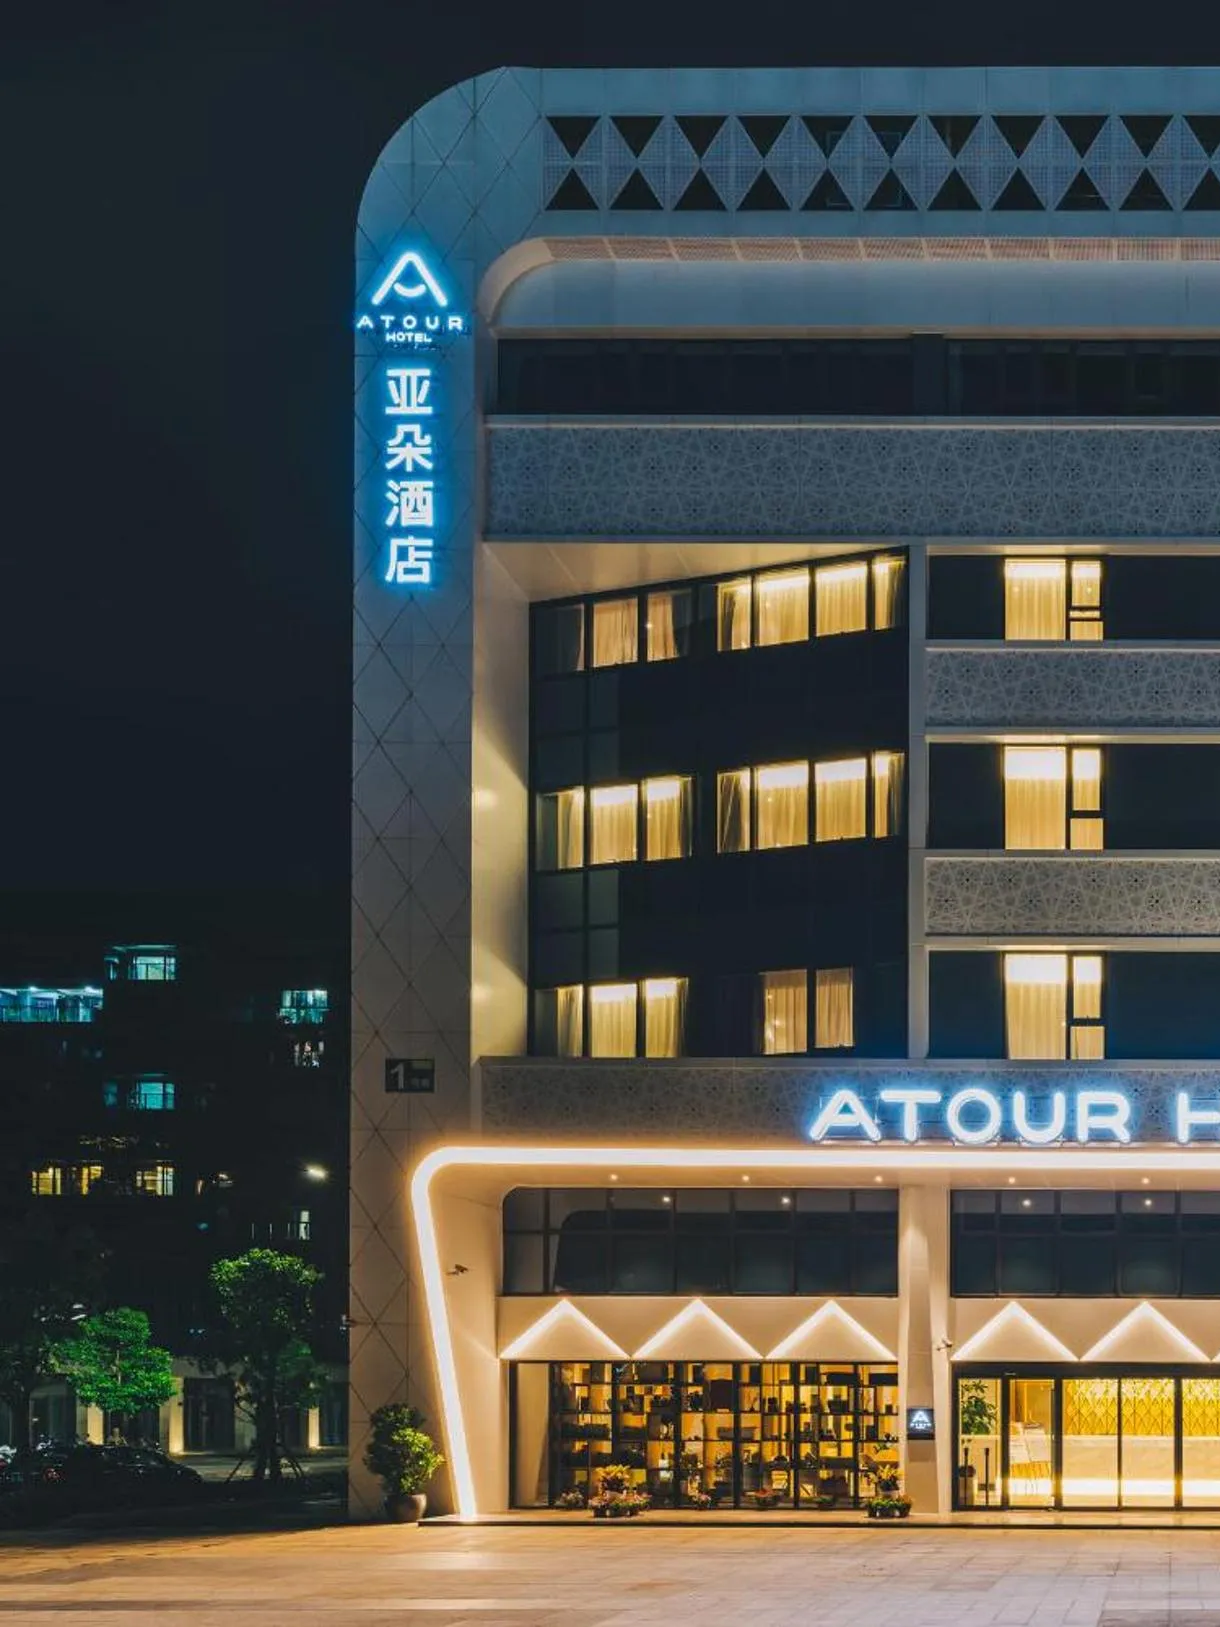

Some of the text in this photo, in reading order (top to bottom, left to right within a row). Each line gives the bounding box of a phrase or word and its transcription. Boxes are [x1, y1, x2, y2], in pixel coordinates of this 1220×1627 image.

[356, 314, 464, 330] ATOUR
[385, 332, 433, 343] HOTEL
[384, 367, 434, 585] 亚朵酒店
[808, 1088, 1131, 1144] ATOUR
